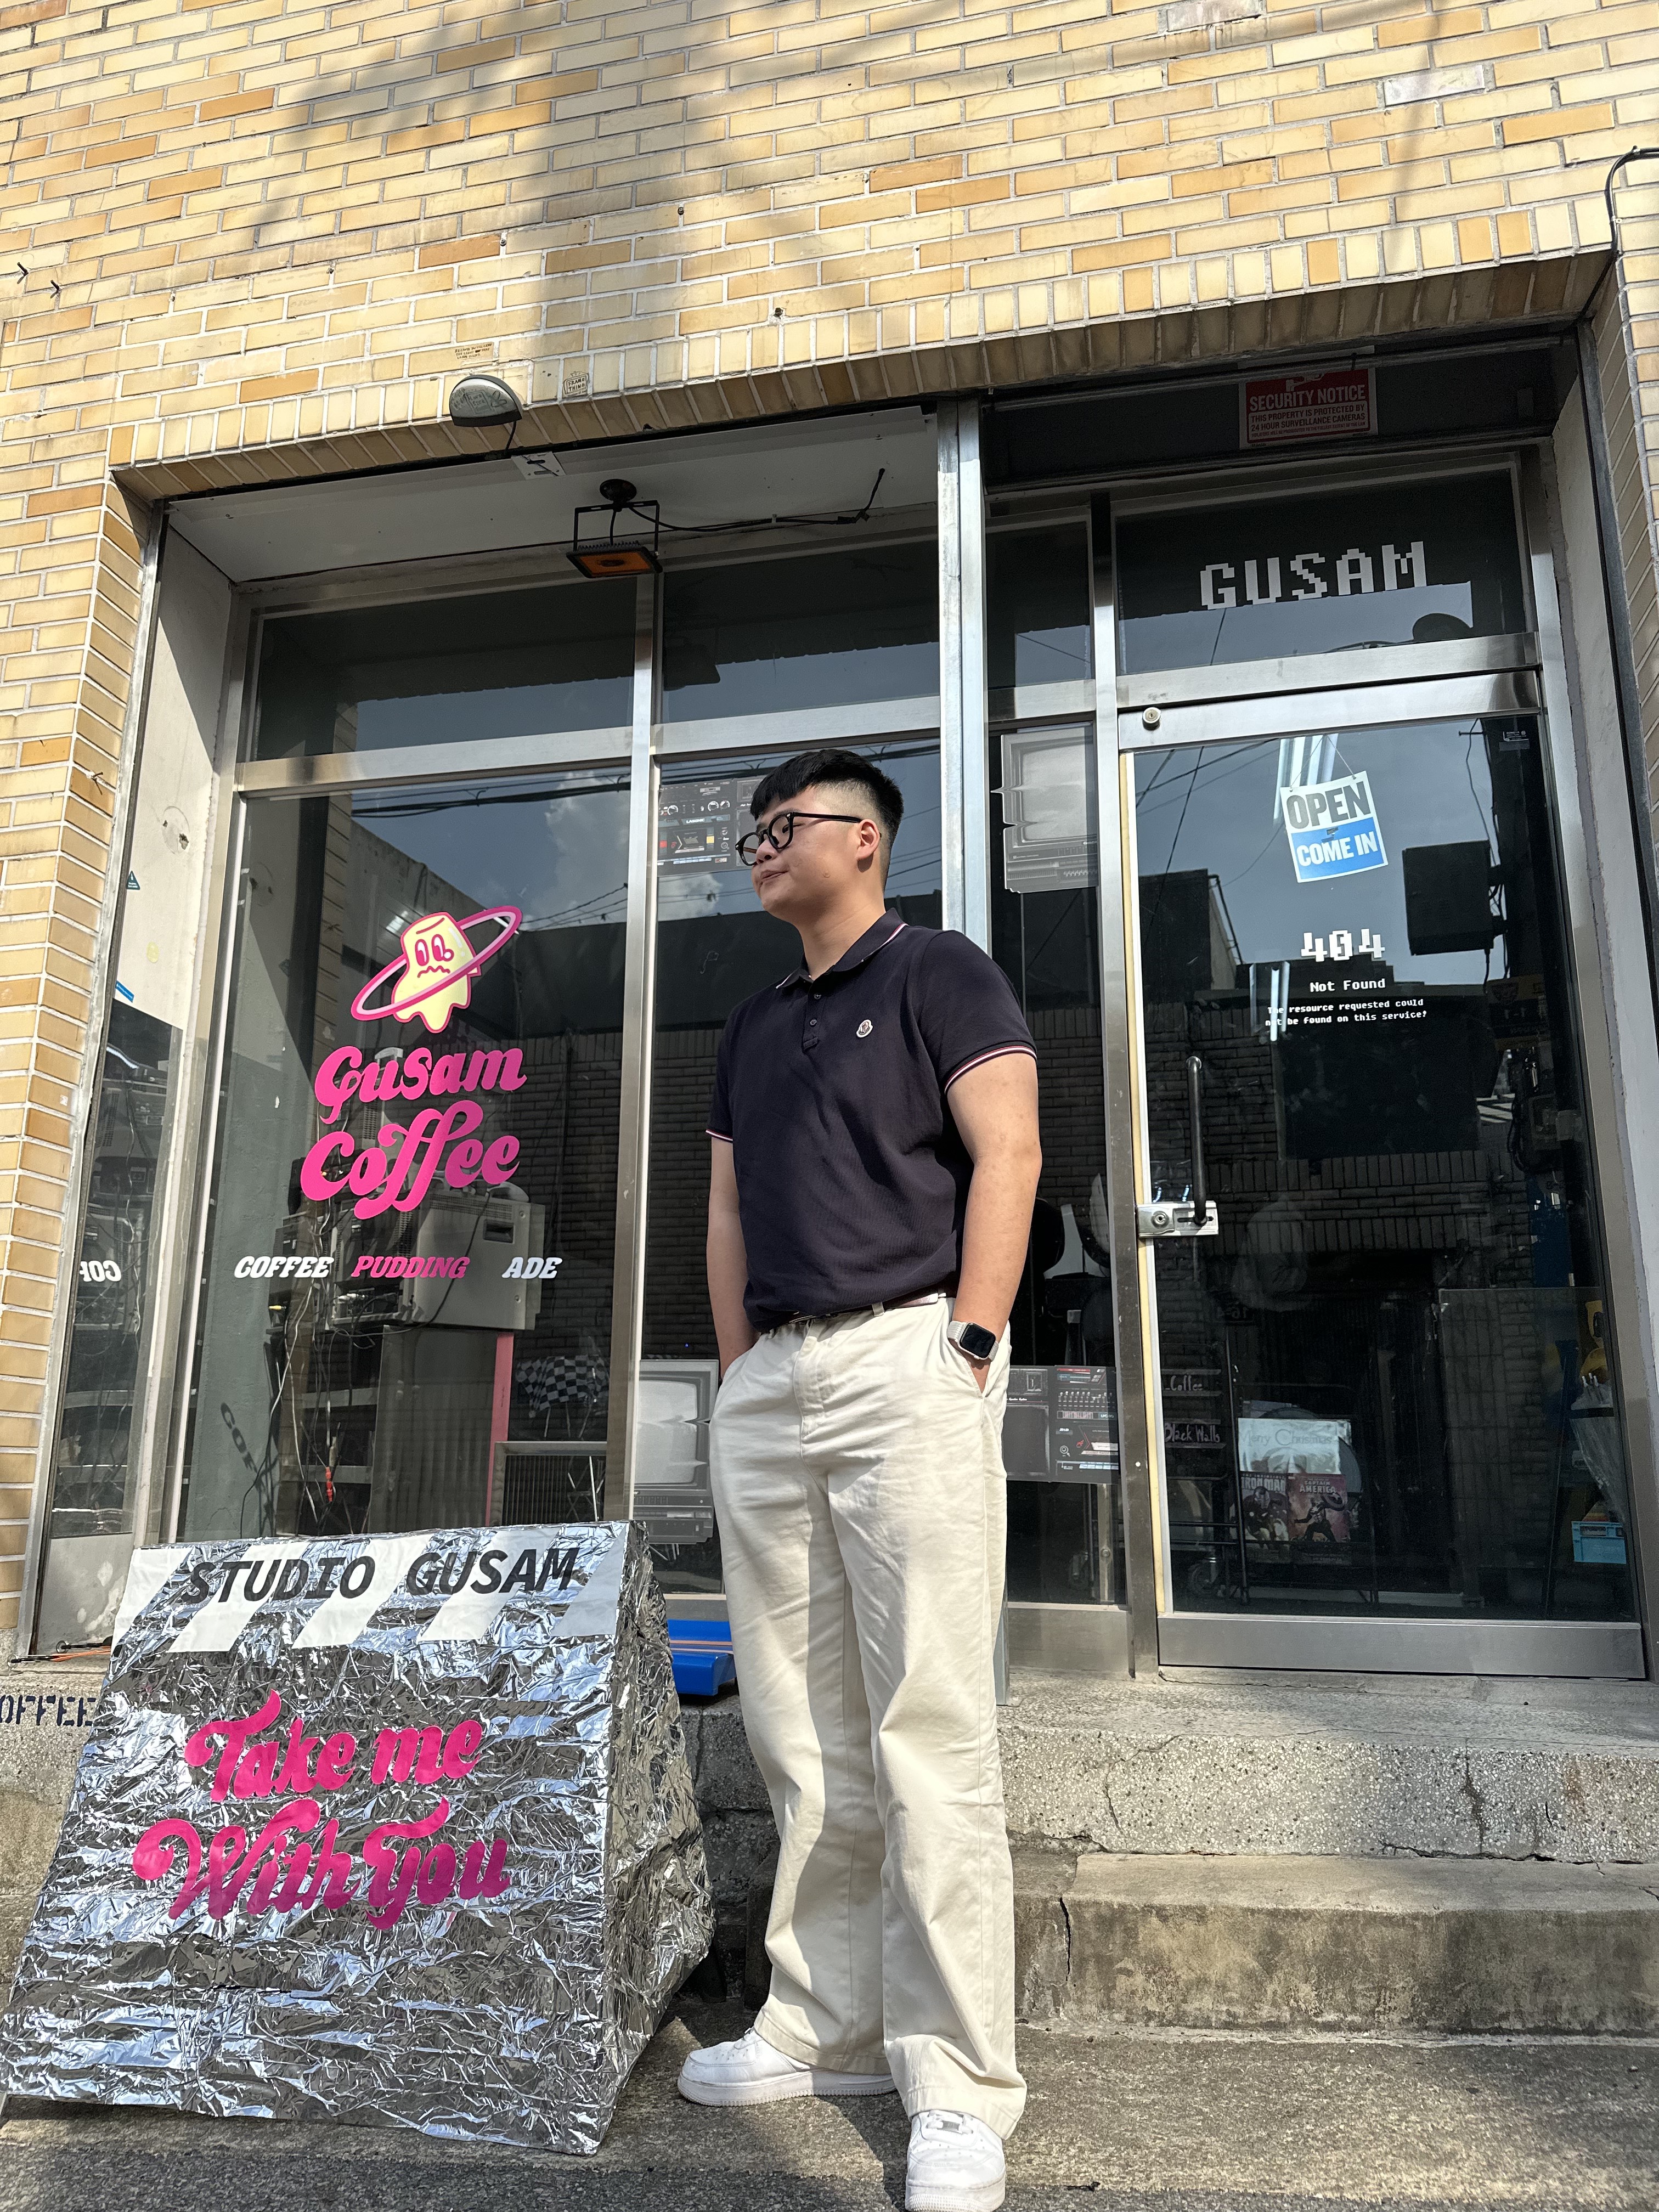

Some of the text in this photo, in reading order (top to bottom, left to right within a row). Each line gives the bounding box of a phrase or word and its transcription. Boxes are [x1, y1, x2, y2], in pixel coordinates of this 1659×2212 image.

[568, 377, 585, 386] FRAME
[568, 383, 585, 391] THING
[1249, 384, 1366, 411] SECURITY NOTICE
[1251, 414, 1267, 423] THIS
[1268, 410, 1304, 421] PROPERTY
[1314, 405, 1353, 416] PROTECTED
[1261, 421, 1280, 430] HOUR
[1281, 416, 1333, 428] SURVEILLANCE
[1333, 413, 1365, 422] CAMERAS
[1200, 541, 1427, 610] GUSAM
[1286, 781, 1372, 829] OPEN
[1296, 831, 1378, 867] COME IN
[1301, 928, 1385, 962] 404
[1310, 978, 1386, 992] Not Found
[1289, 1004, 1334, 1013] resource
[1339, 1000, 1390, 1011] requested
[1395, 998, 1424, 1008] could
[1304, 1015, 1332, 1024] found
[1354, 1013, 1376, 1022] this
[1382, 1010, 1427, 1020] service!
[314, 1046, 527, 1124] Gusam
[300, 1100, 520, 1220] Coffee
[234, 1256, 562, 1279] COFFEE PUDDING ADE
[1164, 1423, 1192, 1442] Black
[1299, 1483, 1337, 1493] AMERICA
[182, 1548, 579, 1605] STUDIO GUSAM
[184, 1688, 483, 1802] Take me
[132, 1798, 360, 1920] With
